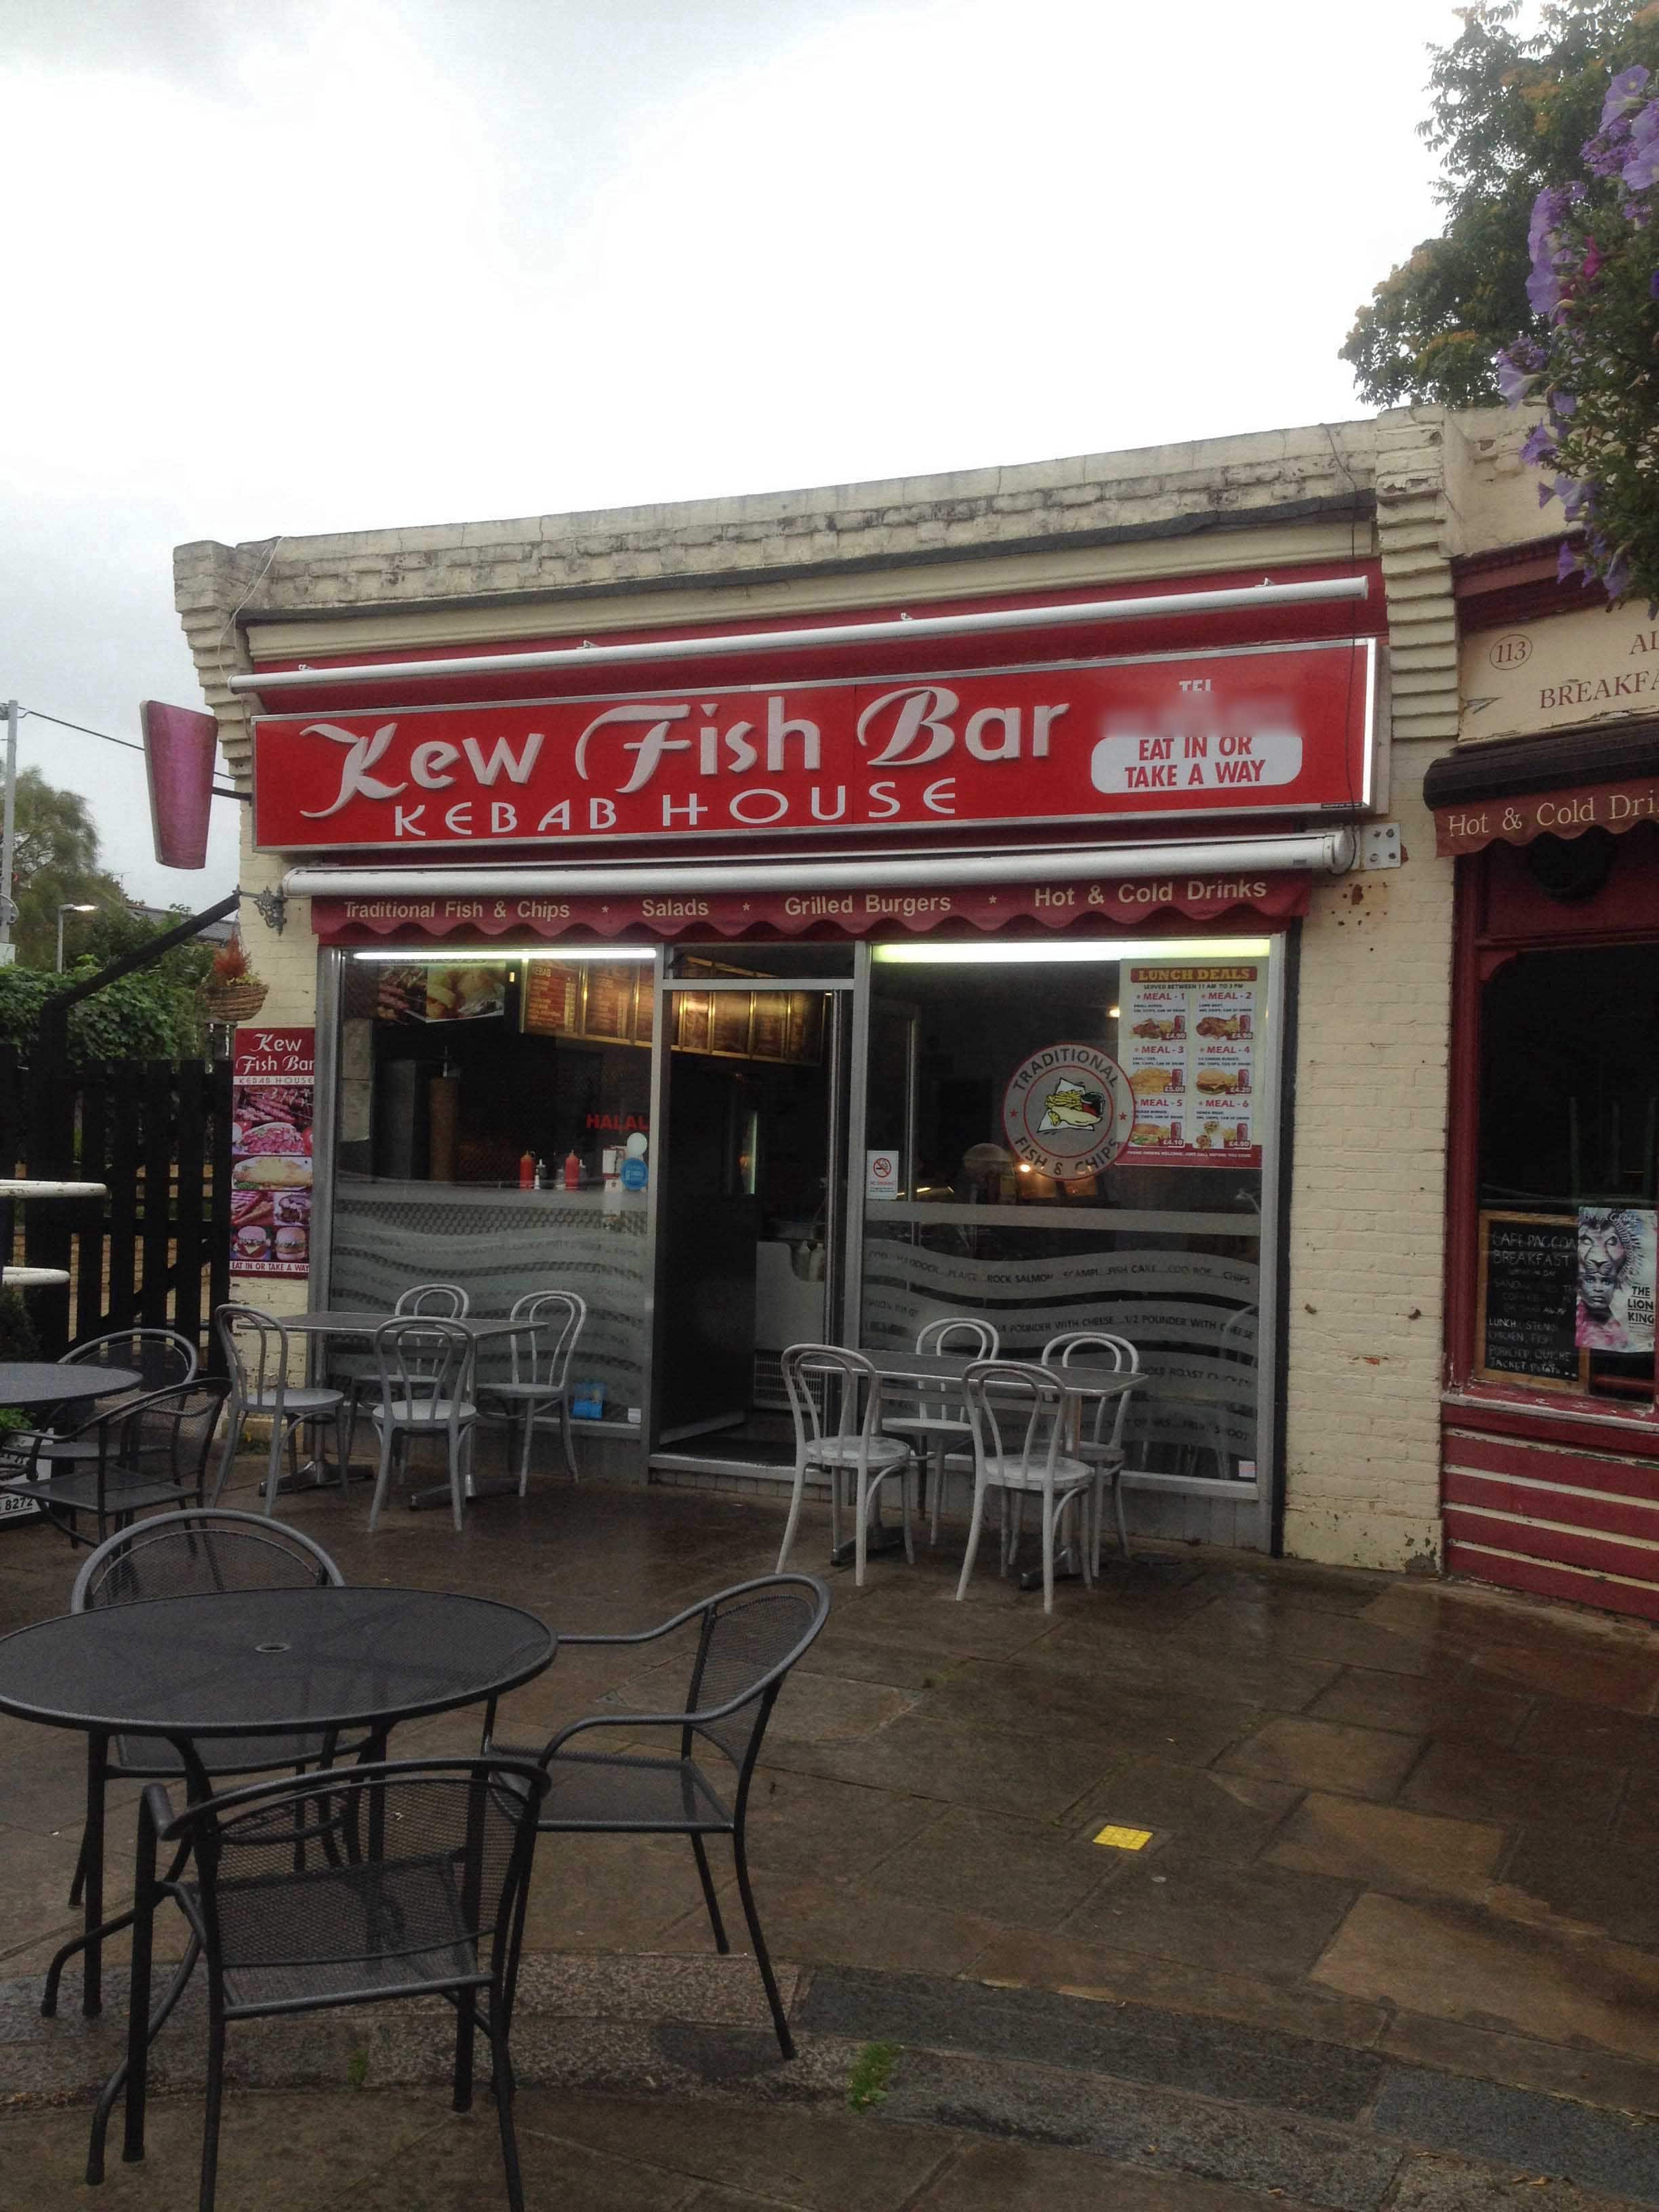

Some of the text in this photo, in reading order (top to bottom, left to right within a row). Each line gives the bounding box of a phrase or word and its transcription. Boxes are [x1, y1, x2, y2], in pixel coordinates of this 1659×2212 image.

[1495, 640, 1527, 663] 113
[300, 685, 1071, 819] Kew Fish Bar
[1139, 737, 1253, 762] EAT IN OR
[1124, 759, 1267, 790] TAKE A WAY
[394, 777, 957, 837] KEBAB HOUSE
[1448, 789, 1659, 838] Hot & Cold Dri
[1034, 878, 1268, 907] Hot & Cold Drinks
[344, 900, 571, 920] Traditional Fish & Chips
[642, 898, 710, 918] Salads
[784, 893, 952, 916] Grilled Burgers
[1138, 968, 1250, 981] LUNCH DEALS
[1143, 992, 1172, 1001] MEAL
[1181, 992, 1185, 1001] 1
[1208, 991, 1237, 1000] MEAL
[1245, 991, 1252, 1000] 2
[249, 1033, 302, 1052] Kew
[1141, 1046, 1171, 1054] MEAL
[1206, 1046, 1237, 1054] MEAL
[1243, 1046, 1250, 1054] 4
[235, 1054, 314, 1076] Fish Bar
[1012, 1048, 1119, 1091] TRADITIONAL
[239, 1076, 272, 1084] KEBAB
[1140, 1099, 1169, 1107] MEAL
[1176, 1099, 1183, 1107] 5
[1205, 1099, 1235, 1108] MEAL
[1242, 1099, 1249, 1107] 6
[586, 1112, 650, 1131] HALAL
[1014, 1136, 1048, 1168] FISH
[232, 1263, 243, 1271] EAT
[294, 1264, 310, 1272] WAY
[1492, 1249, 1570, 1267] BREAKFAST
[987, 1273, 1011, 1284] ROCK
[1014, 1273, 1054, 1284] SALMON
[1632, 1286, 1651, 1296] THE
[1627, 1298, 1654, 1311] LION
[1009, 1322, 1052, 1334] POUNDER
[1054, 1319, 1079, 1330] WITH
[1082, 1315, 1115, 1326] CHEESE
[1142, 1315, 1188, 1325] POUNDER
[1190, 1317, 1216, 1330] WITH
[1627, 1311, 1654, 1324] KING
